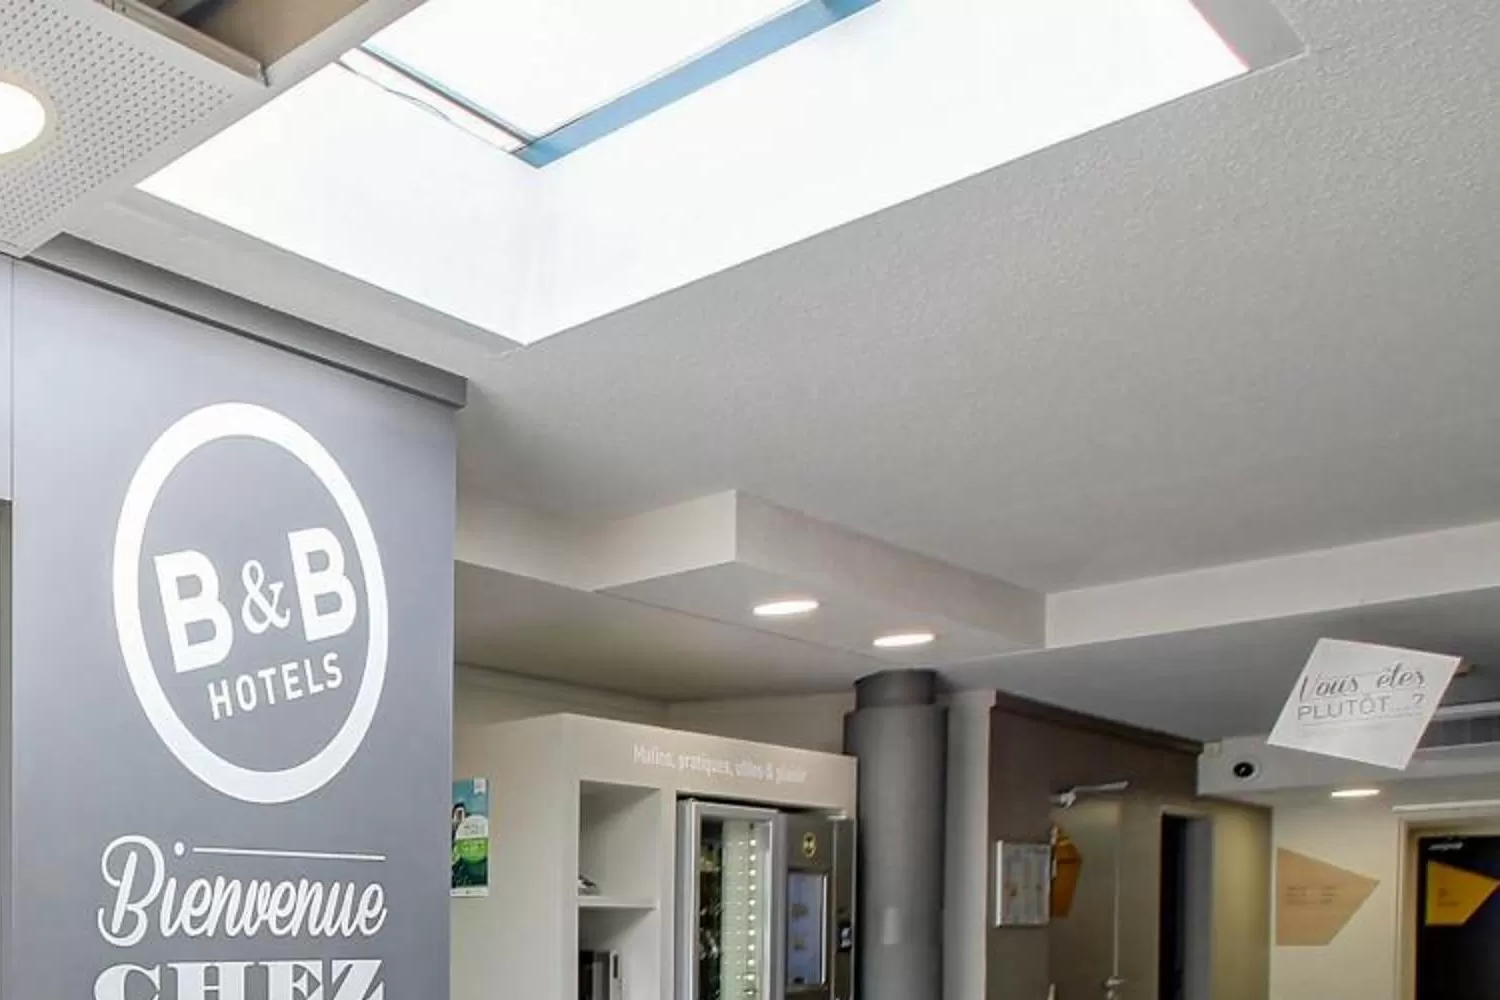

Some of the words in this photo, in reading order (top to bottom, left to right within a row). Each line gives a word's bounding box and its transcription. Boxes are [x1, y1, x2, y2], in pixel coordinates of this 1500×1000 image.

[153, 527, 357, 673] B&B
[207, 652, 343, 720] HOTELS
[1299, 673, 1359, 701] Vous
[97, 834, 388, 947] Bienvenue
